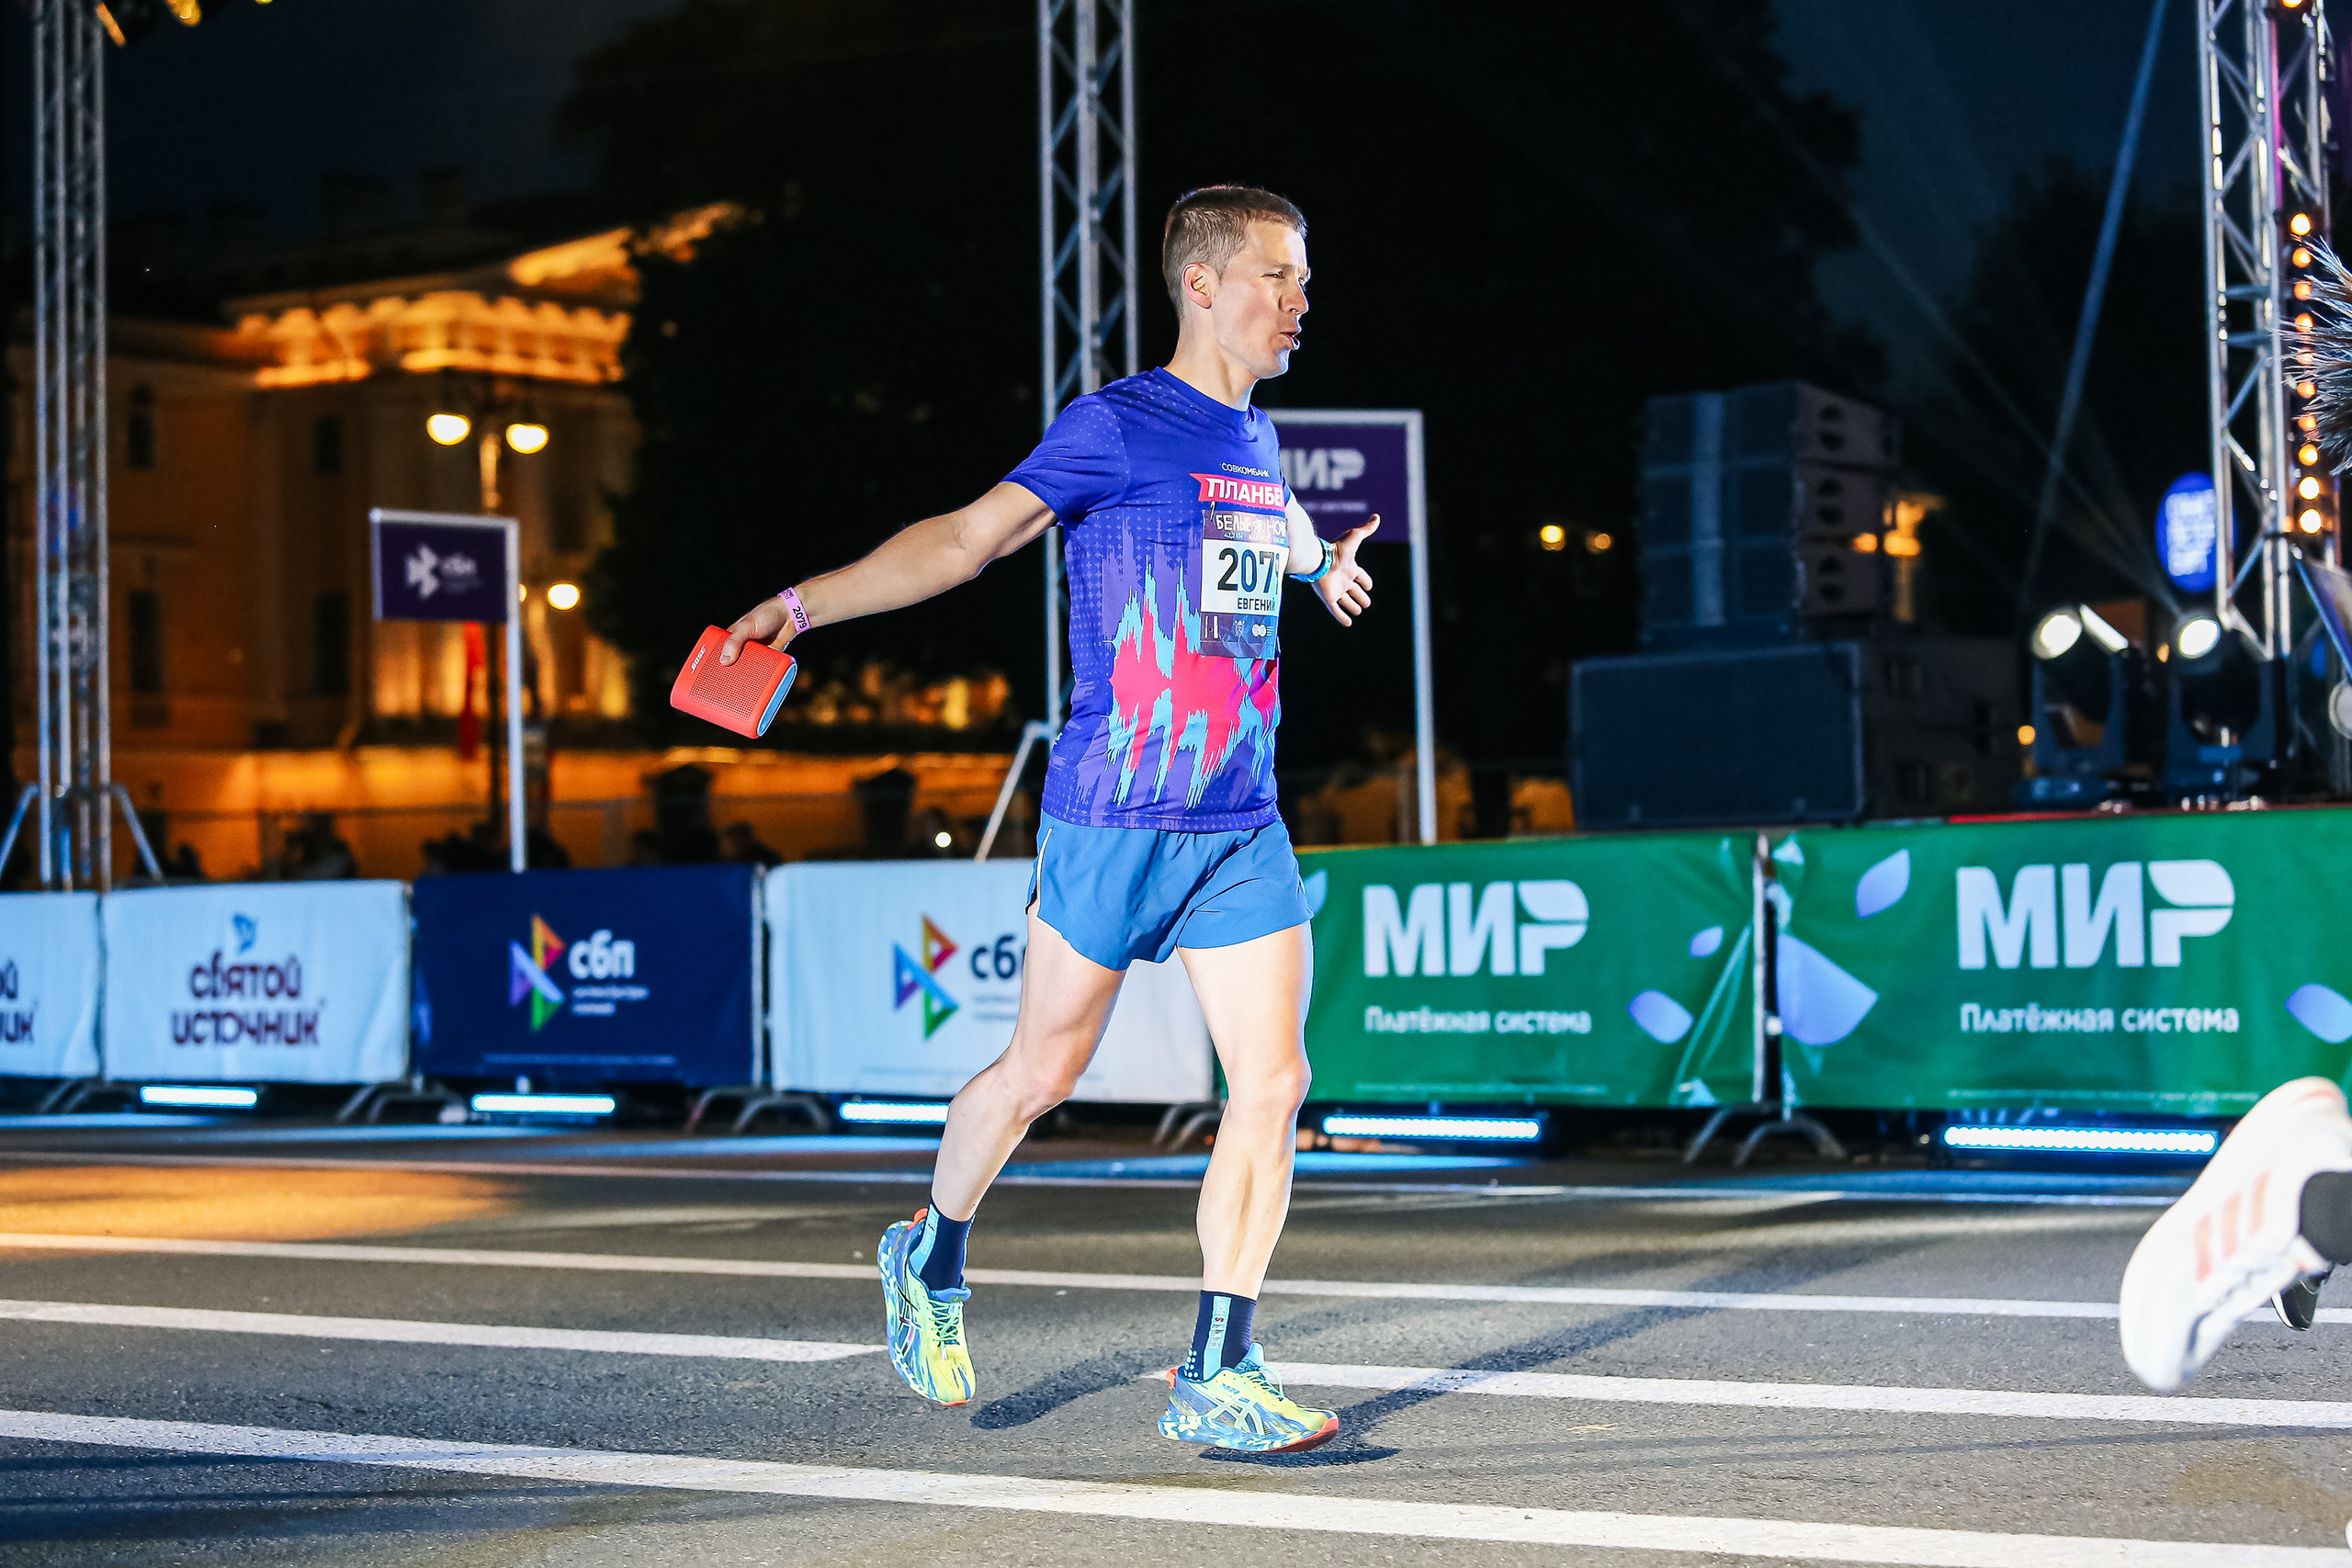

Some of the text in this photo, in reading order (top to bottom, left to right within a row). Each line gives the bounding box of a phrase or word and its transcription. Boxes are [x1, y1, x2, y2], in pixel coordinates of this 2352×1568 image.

[1220, 462, 1271, 478] СОВКОМБАНК
[1216, 513, 1251, 533] БЕЛЫЕ
[792, 605, 808, 629] 2079
[690, 644, 707, 674] BOSE
[1362, 879, 1589, 977] МИР
[1955, 859, 2235, 970] МИР
[568, 929, 636, 980] сбп
[970, 933, 1027, 980] сб
[1364, 1005, 1592, 1034] Платёжная система
[1961, 1001, 2240, 1033] Платёжная система
